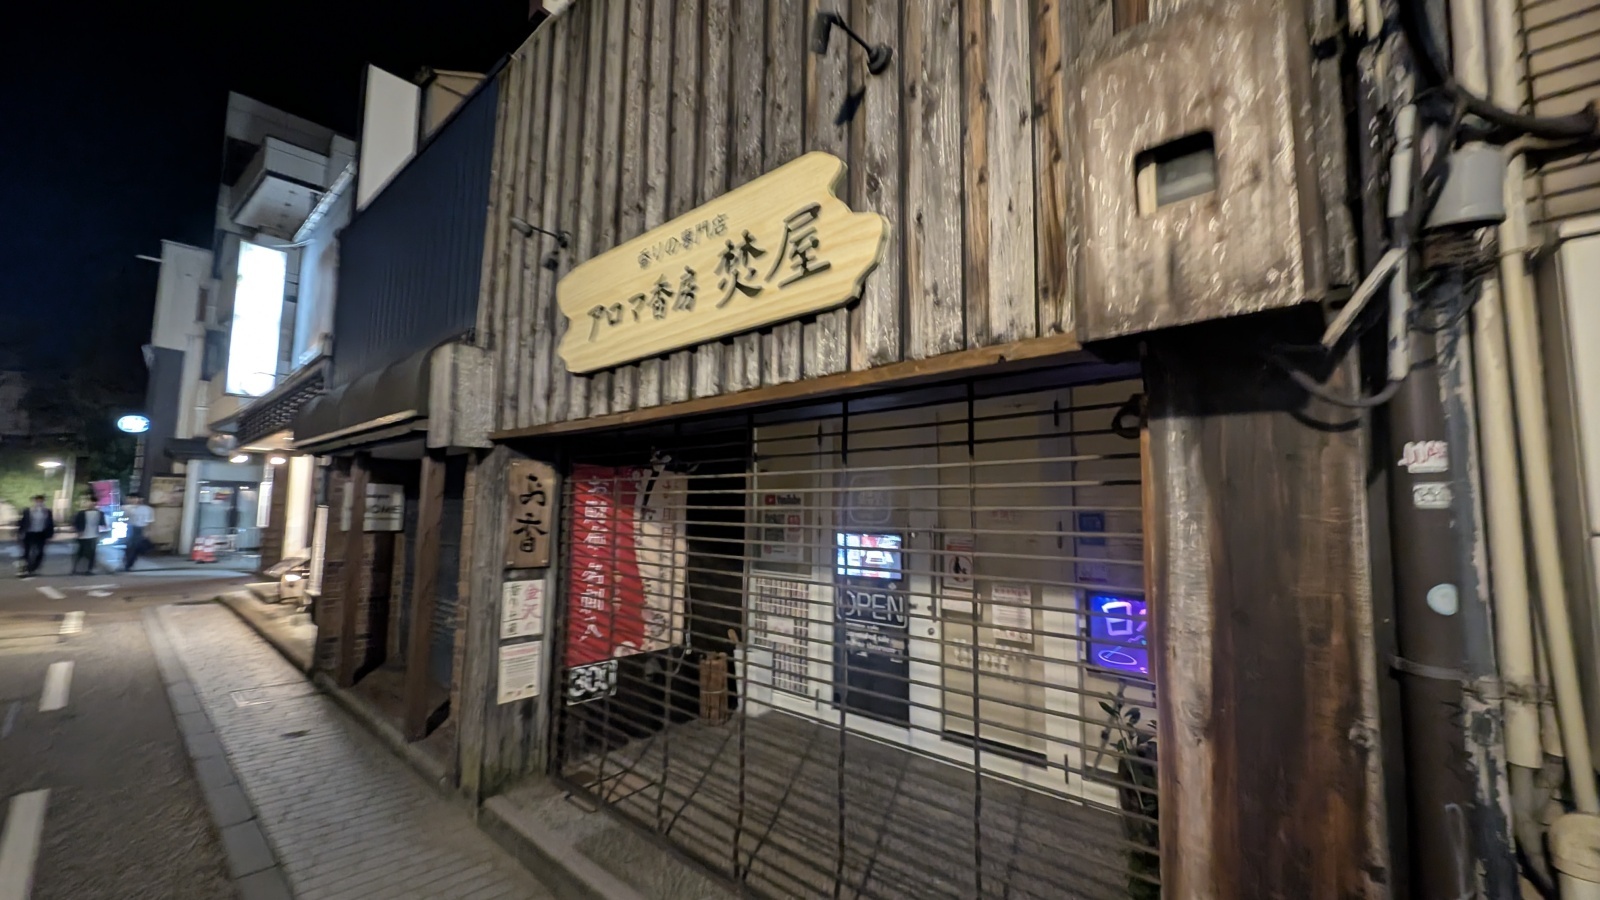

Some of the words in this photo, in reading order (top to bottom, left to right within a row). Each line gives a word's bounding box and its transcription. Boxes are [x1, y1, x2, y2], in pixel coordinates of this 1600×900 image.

[713, 202, 831, 310] 焚屋
[513, 473, 549, 553] お香
[840, 589, 904, 623] OPEN
